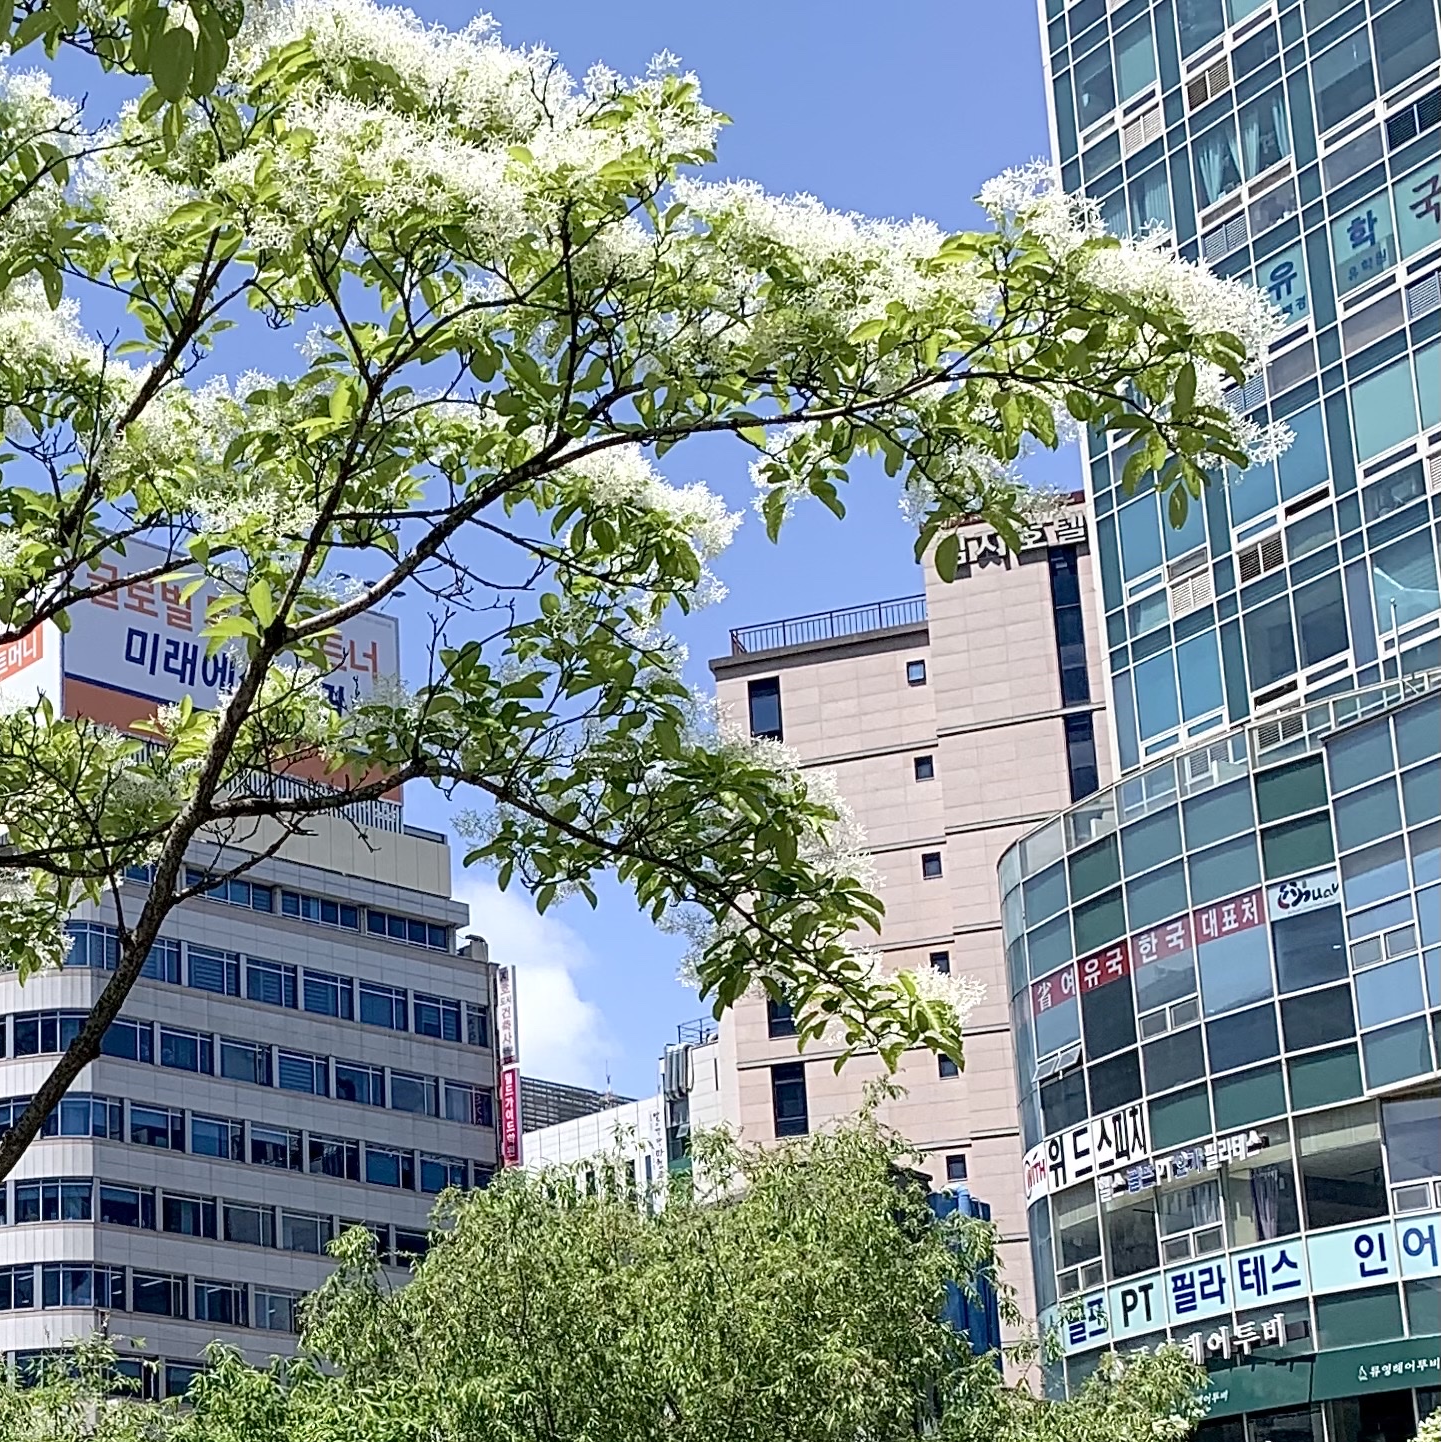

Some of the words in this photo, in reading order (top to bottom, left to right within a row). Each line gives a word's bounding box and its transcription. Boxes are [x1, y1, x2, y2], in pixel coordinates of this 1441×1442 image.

[1060, 948, 1124, 997] 여유국
[1138, 918, 1186, 965] 한국
[1201, 893, 1260, 938] 대표처
[1048, 1102, 1148, 1188] 위드스피치
[1204, 1130, 1263, 1171] 필라테스
[1120, 1282, 1155, 1328] PT
[1170, 1249, 1302, 1315] 필라테스
